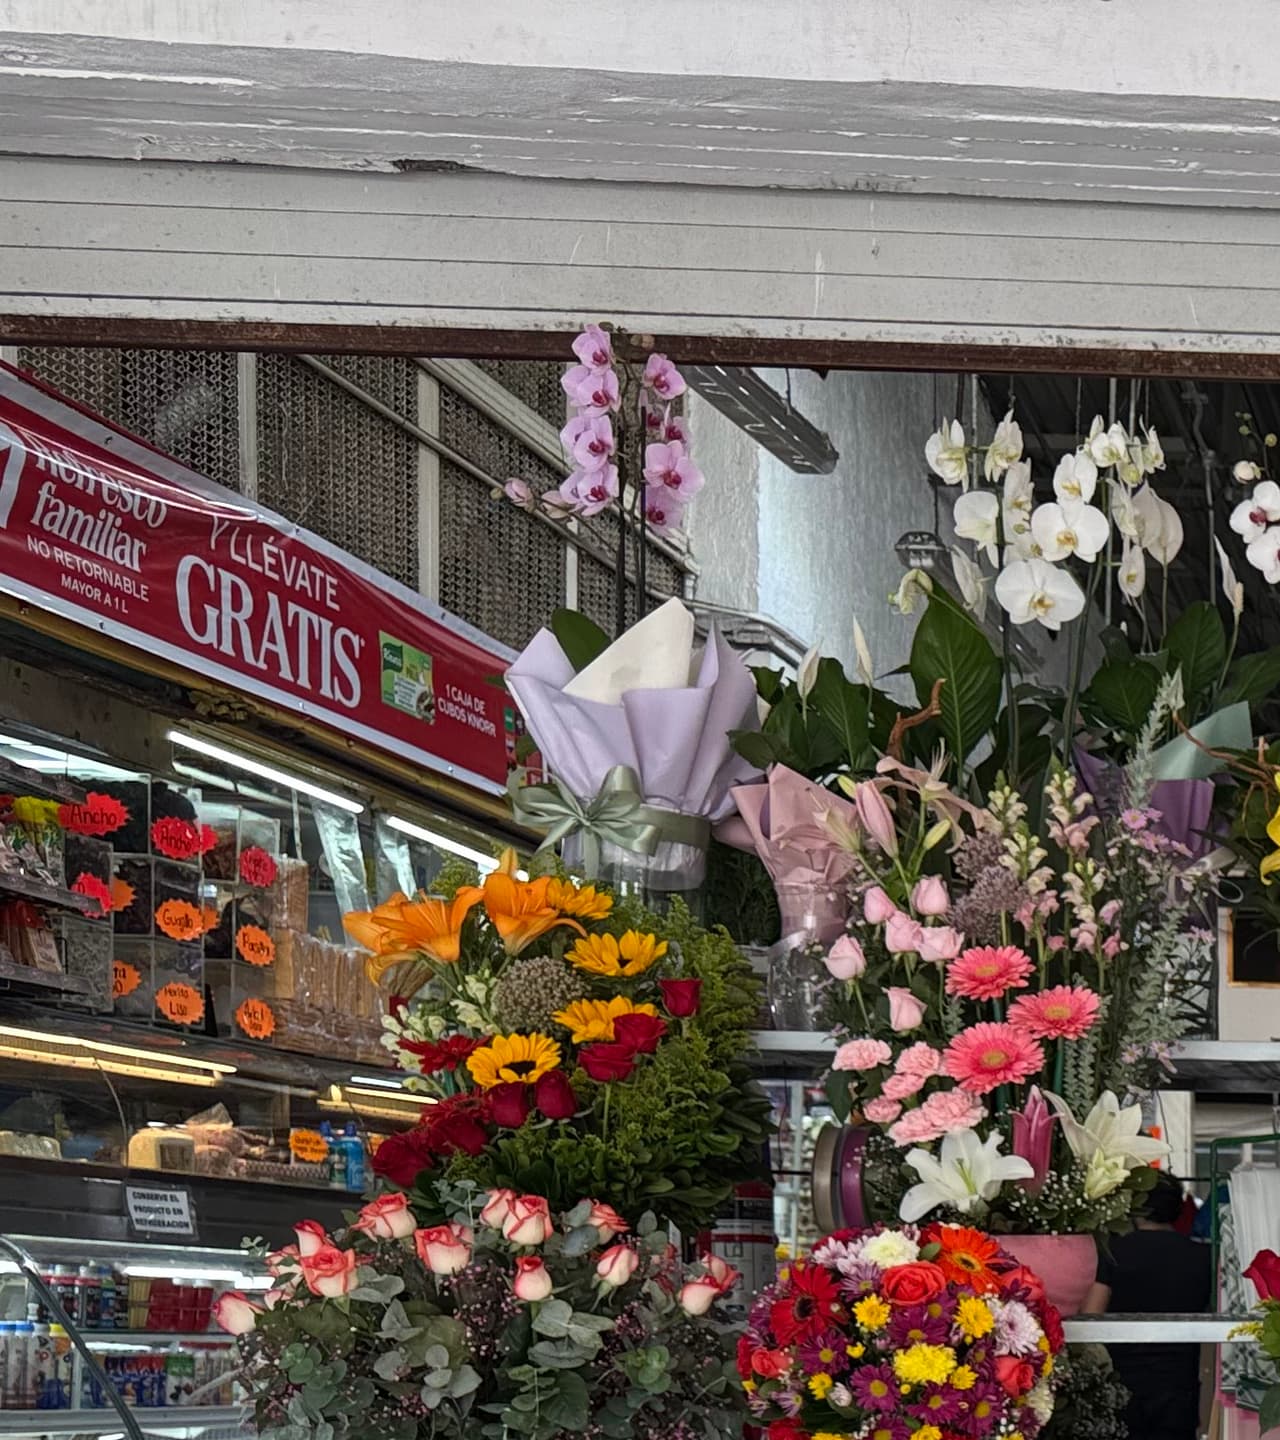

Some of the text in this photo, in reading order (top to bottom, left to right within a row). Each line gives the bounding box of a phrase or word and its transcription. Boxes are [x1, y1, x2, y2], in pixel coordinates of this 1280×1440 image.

[30, 481, 146, 573] familiar
[27, 534, 150, 602] NO RETORNABLE
[211, 515, 340, 612] Y LLÉVATE
[61, 573, 101, 602] MAYOR
[104, 591, 112, 607] A
[122, 598, 129, 614] L
[438, 697, 497, 738] CUBOS KNORR
[451, 686, 473, 710] CAJA
[474, 697, 486, 716] DE
[70, 805, 118, 826] Ancho
